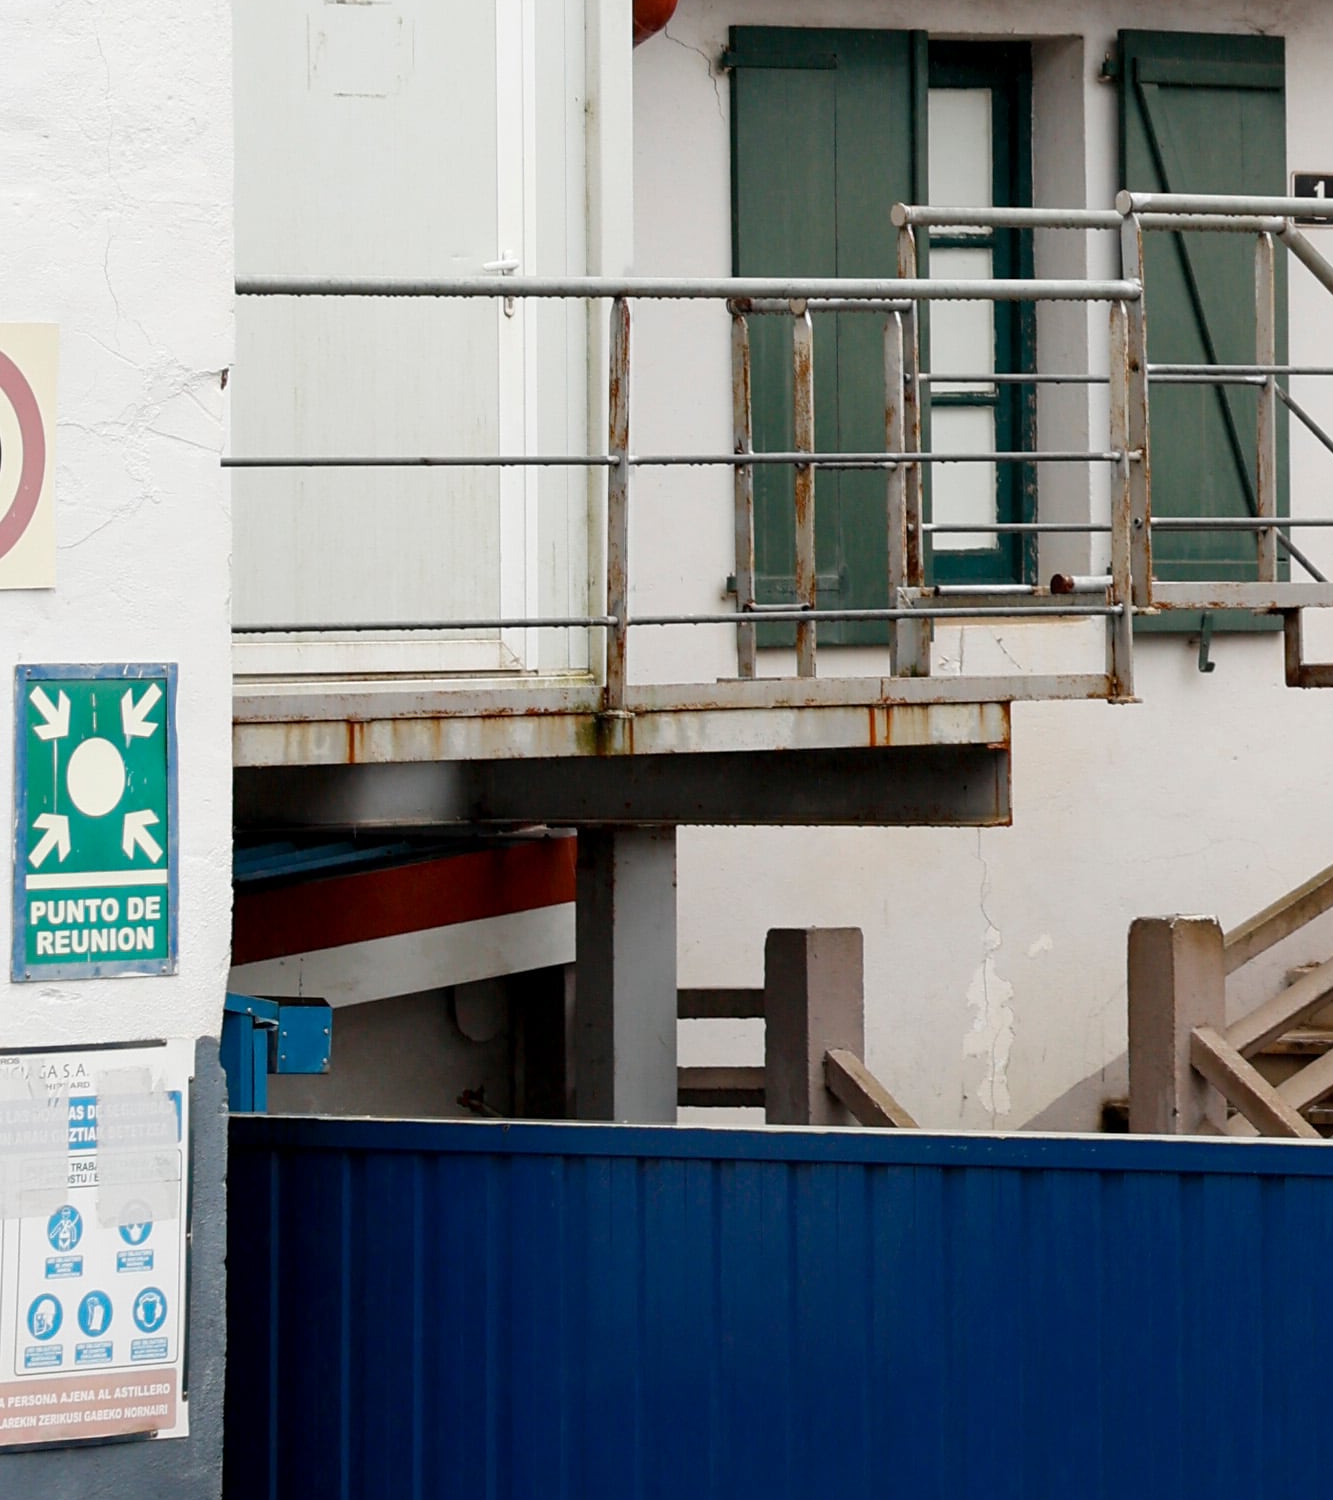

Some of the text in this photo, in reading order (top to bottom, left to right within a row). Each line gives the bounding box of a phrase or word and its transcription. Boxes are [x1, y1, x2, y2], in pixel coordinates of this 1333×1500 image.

[30, 896, 161, 925] PUNTO DE
[36, 926, 155, 955] REUNION
[8, 1393, 57, 1408] PERSONA
[60, 1390, 95, 1404] AJENA
[98, 1388, 111, 1400] AL
[114, 1383, 170, 1399] ASTILLERO
[84, 1408, 122, 1422] GABEKO
